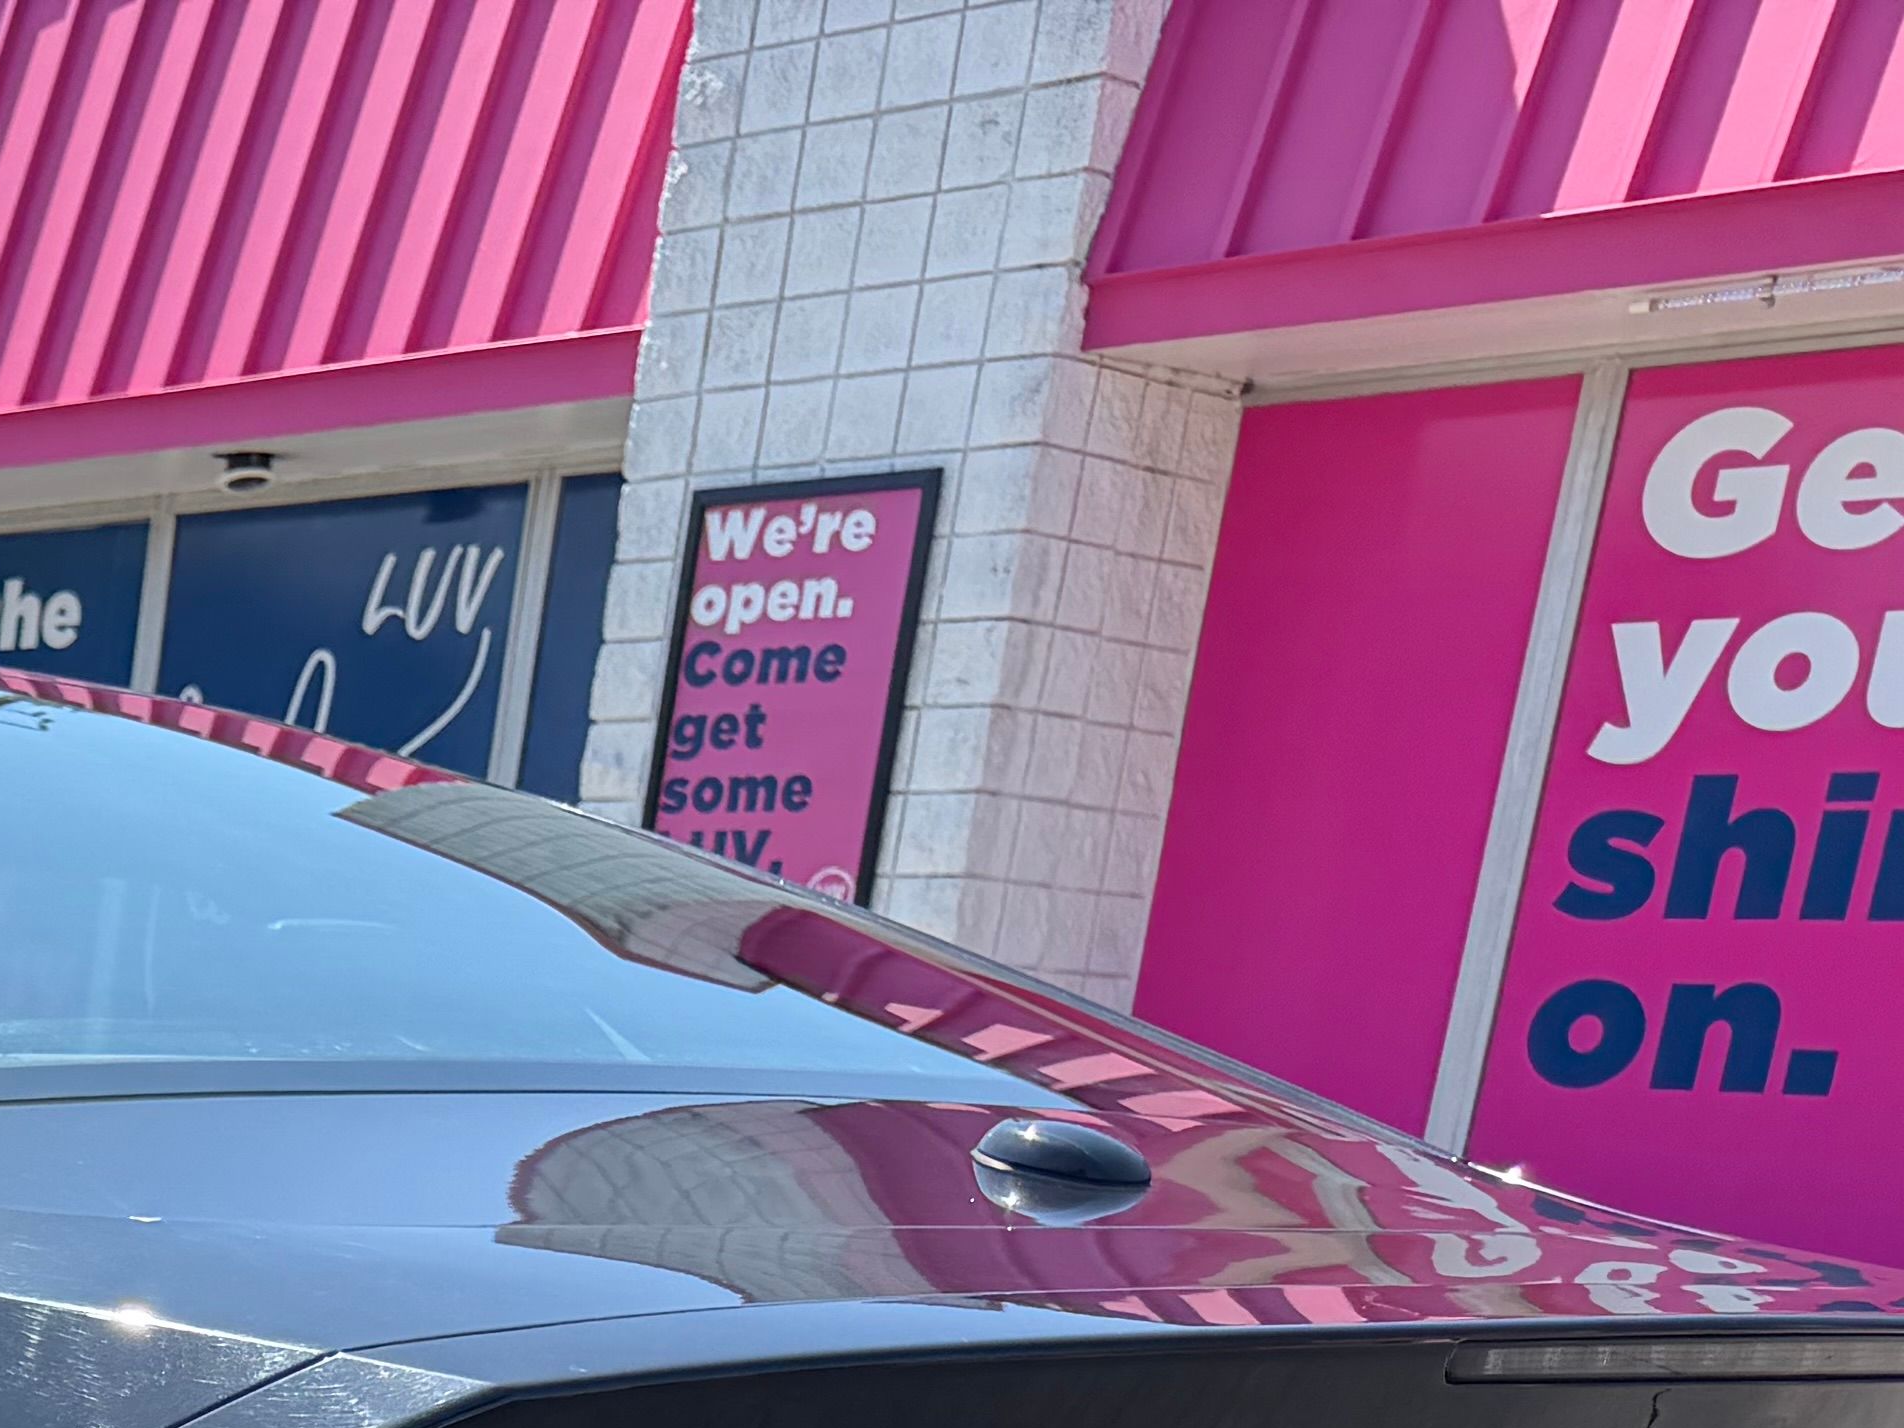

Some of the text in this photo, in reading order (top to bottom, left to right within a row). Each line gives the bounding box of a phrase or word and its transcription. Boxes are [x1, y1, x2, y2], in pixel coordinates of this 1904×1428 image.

[706, 503, 877, 561] We're
[361, 543, 504, 640] LUV
[690, 577, 854, 635] open.
[683, 640, 847, 689] Come
[671, 704, 767, 760] get
[658, 772, 813, 815] some
[1526, 977, 1840, 1097] on.
